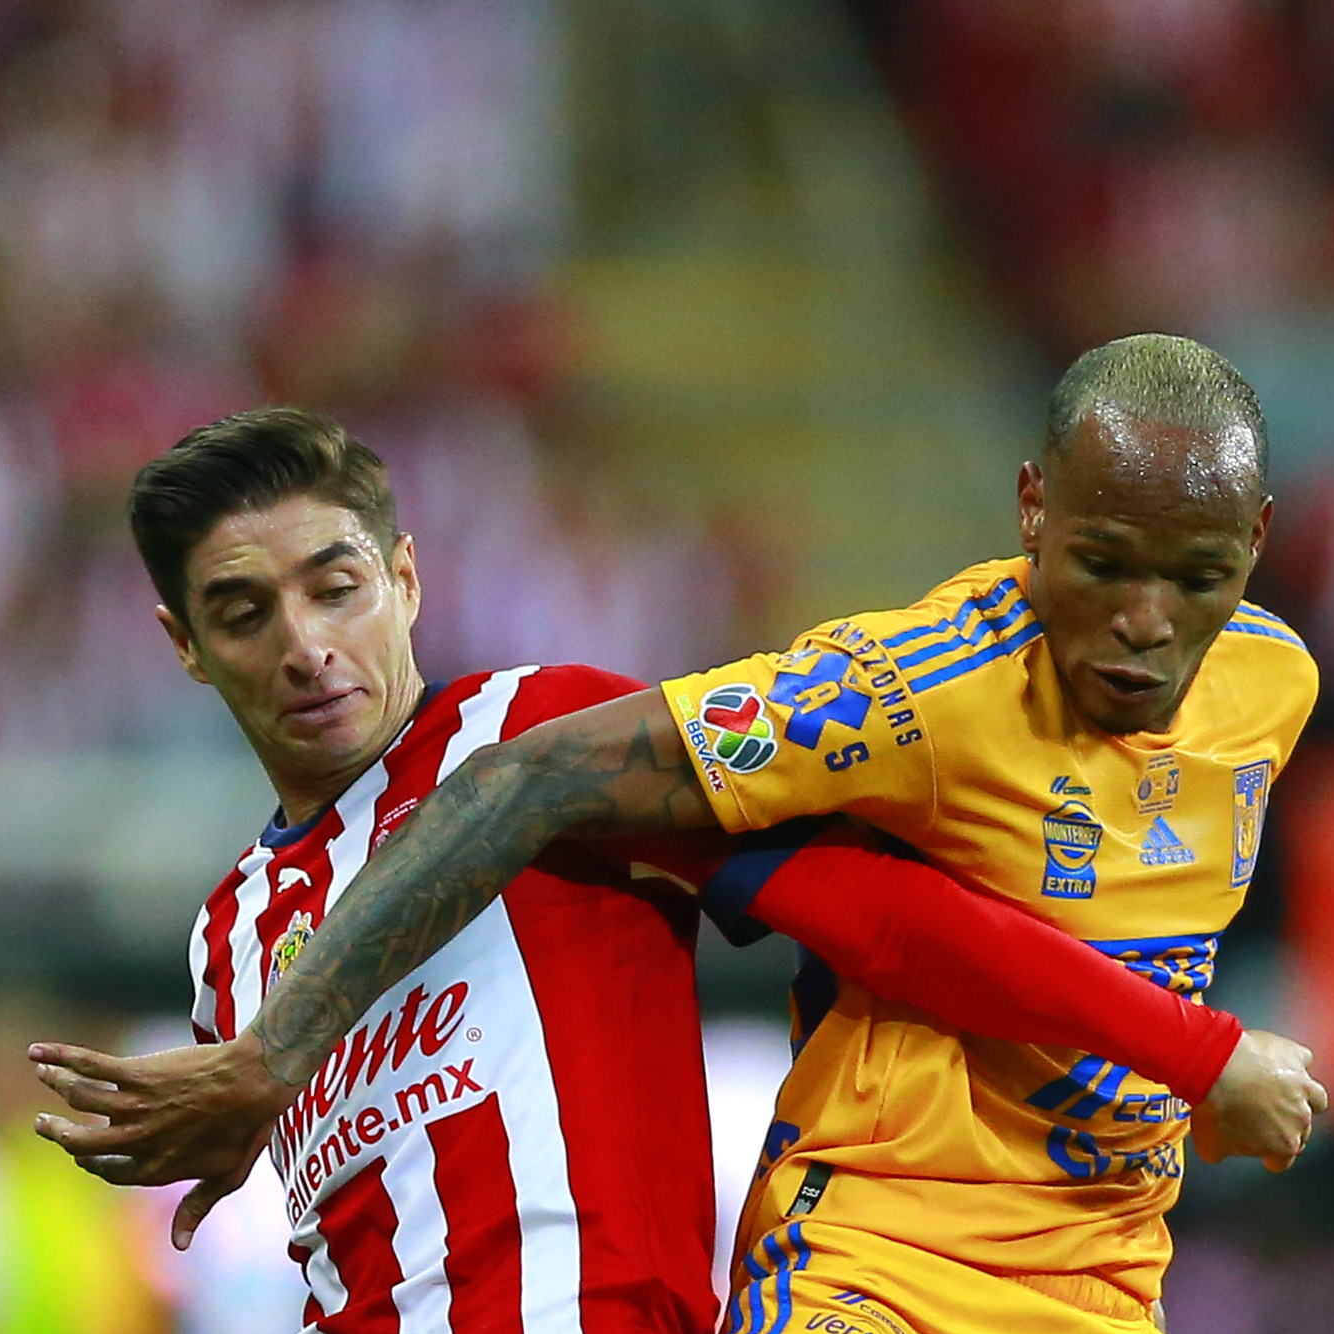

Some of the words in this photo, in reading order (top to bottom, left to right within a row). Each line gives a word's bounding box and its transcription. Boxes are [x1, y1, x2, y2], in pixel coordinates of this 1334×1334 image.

[830, 622, 922, 746] AMAZONAS
[686, 719, 715, 769] BBVA
[707, 769, 725, 794] MX
[1046, 876, 1093, 894] EXTRA
